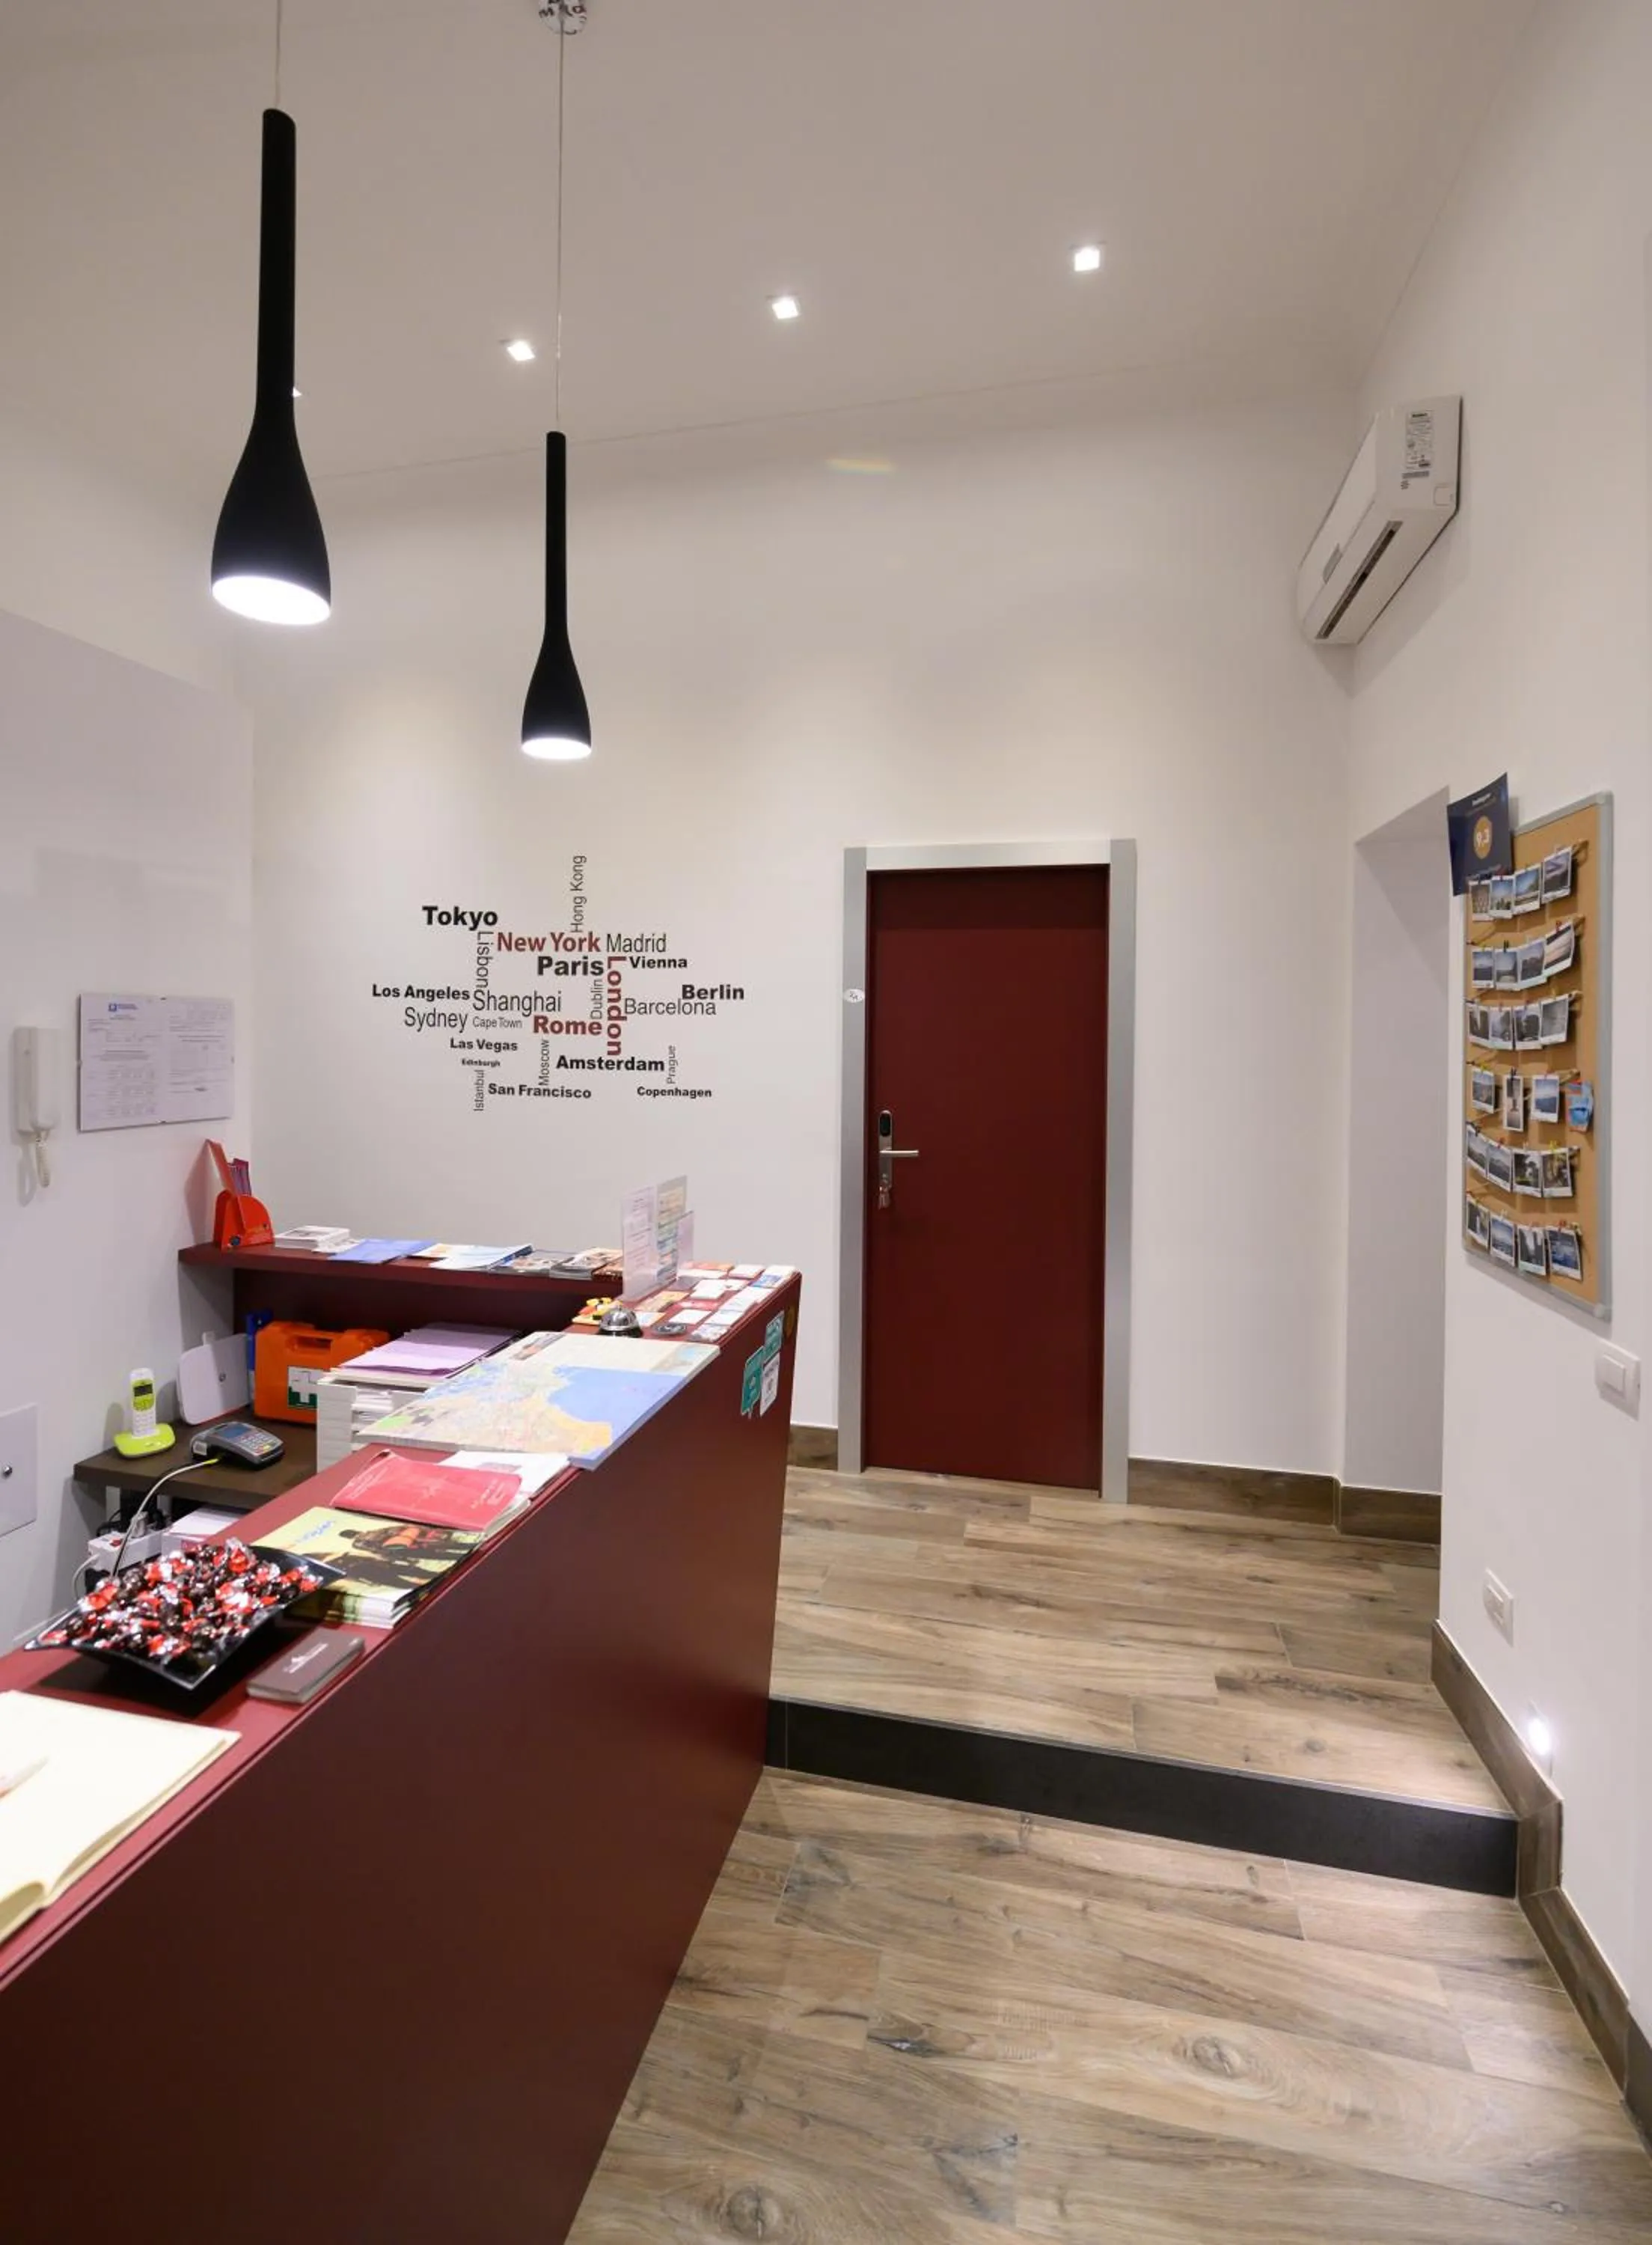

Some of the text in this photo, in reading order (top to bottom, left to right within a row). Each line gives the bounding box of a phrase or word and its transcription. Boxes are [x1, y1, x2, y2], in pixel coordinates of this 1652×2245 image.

[570, 855, 587, 933] Hong Kong
[422, 905, 498, 932] Tokyo
[497, 931, 602, 953] New York
[606, 932, 667, 953] Madrid
[476, 930, 494, 989] Lisbon
[536, 955, 605, 977] Paris
[628, 956, 688, 970] Vienna
[372, 983, 471, 1004] Los Angeles
[472, 989, 561, 1018] Shanghai
[590, 978, 604, 1020] Dublin
[682, 984, 744, 1001] Berlin
[607, 956, 628, 1057] London
[624, 997, 717, 1016] Barcelona
[404, 1007, 468, 1033] Sydney
[472, 1015, 523, 1030] Cape Town
[533, 1015, 602, 1036] Rome
[450, 1037, 518, 1054] Las Vegas
[537, 1039, 550, 1087] Moscow
[555, 1054, 664, 1072] Amsterdam
[666, 1045, 679, 1084] Prague
[473, 1069, 485, 1112] Istanbul
[488, 1083, 592, 1099] San Francisco
[637, 1086, 712, 1099] Copenhagen
